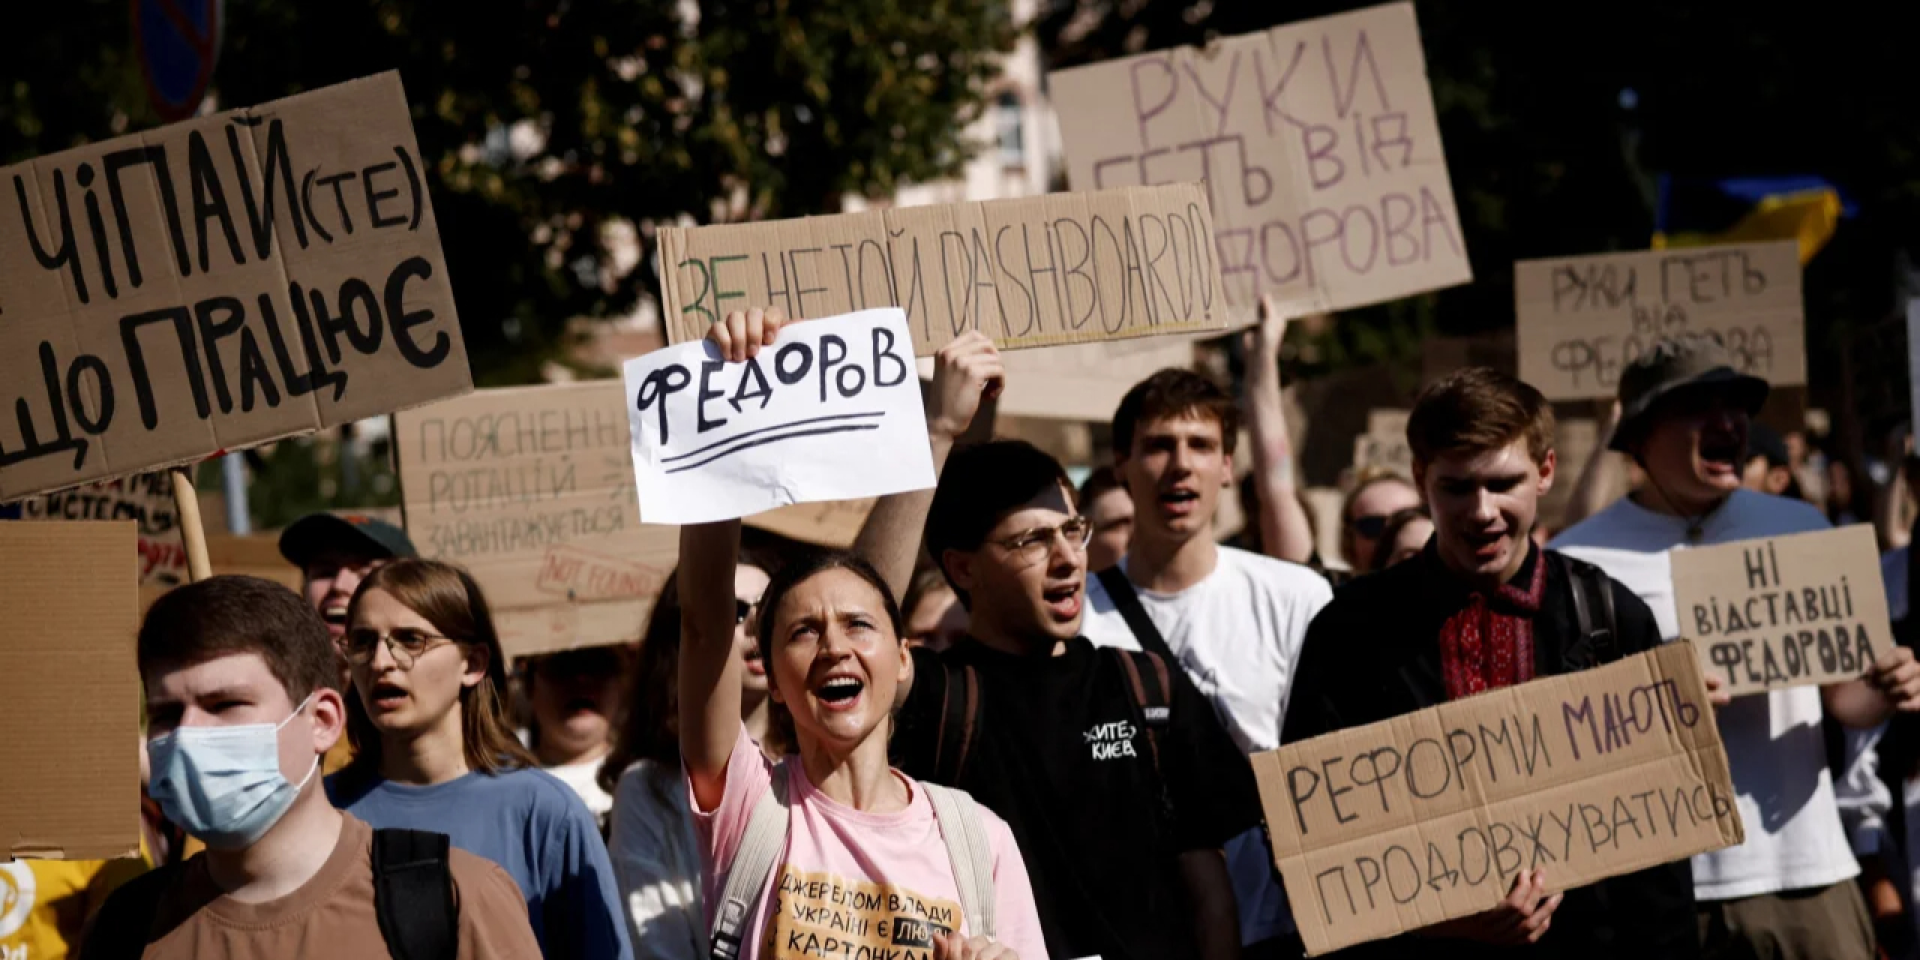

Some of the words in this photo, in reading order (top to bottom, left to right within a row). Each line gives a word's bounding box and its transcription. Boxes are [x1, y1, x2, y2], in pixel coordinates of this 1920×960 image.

[1129, 28, 1392, 150] РУКИ
[1303, 112, 1413, 190] ВІД
[1214, 186, 1463, 306] ДОРОВА
[1661, 250, 1768, 304] ГЕТЬ
[120, 256, 451, 431] ПРАЦЮЄ
[637, 326, 908, 446] ФЕДОРОВ
[419, 408, 632, 463] ПОЯСНЕНН
[429, 455, 578, 513] РОТАЦІЙ
[1743, 540, 1780, 589] НІ
[1693, 575, 1853, 636] ВІДСТАВЦІ
[1710, 623, 1877, 686] ФЕДОРОВА
[1287, 713, 1552, 834] РЕФОРМИ
[1562, 679, 1700, 762] МАЮТЬ
[1316, 783, 1733, 925] ПРОДОВЖУВАТИСЬ
[779, 873, 882, 913] ДЖЕРЕЛОМ
[889, 893, 953, 924] ВЛАДИ
[793, 902, 869, 938] УКРАЇНІ
